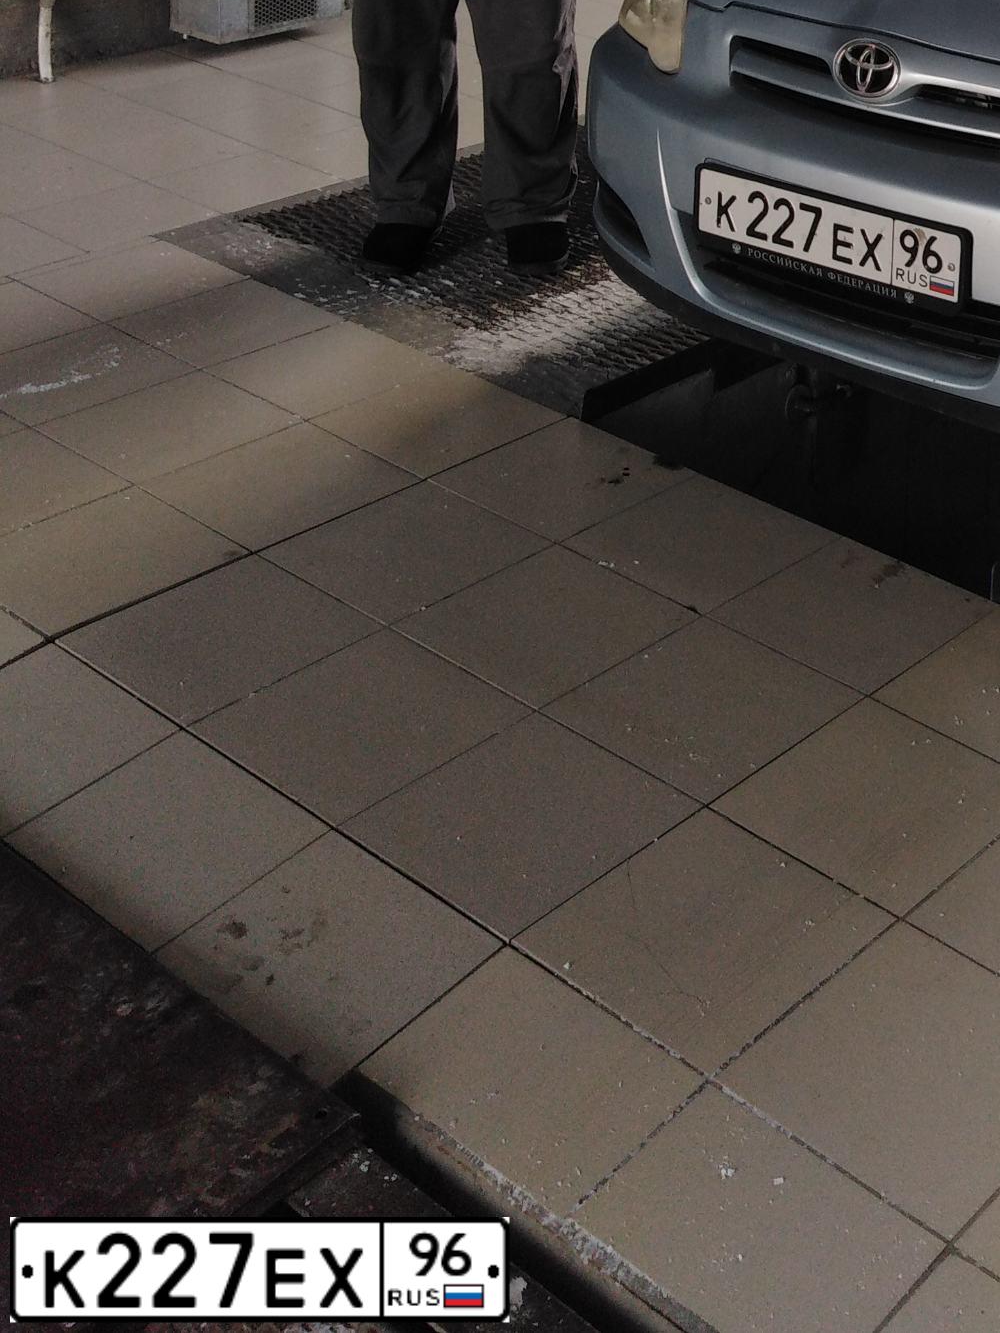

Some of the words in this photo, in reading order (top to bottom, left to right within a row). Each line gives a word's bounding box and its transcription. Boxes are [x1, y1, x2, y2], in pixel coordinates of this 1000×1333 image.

[747, 248, 823, 278] РОССИЙСКАЯ
[827, 271, 897, 298] ФЕДЕРАЦИЯ
[896, 267, 928, 288] RUS
